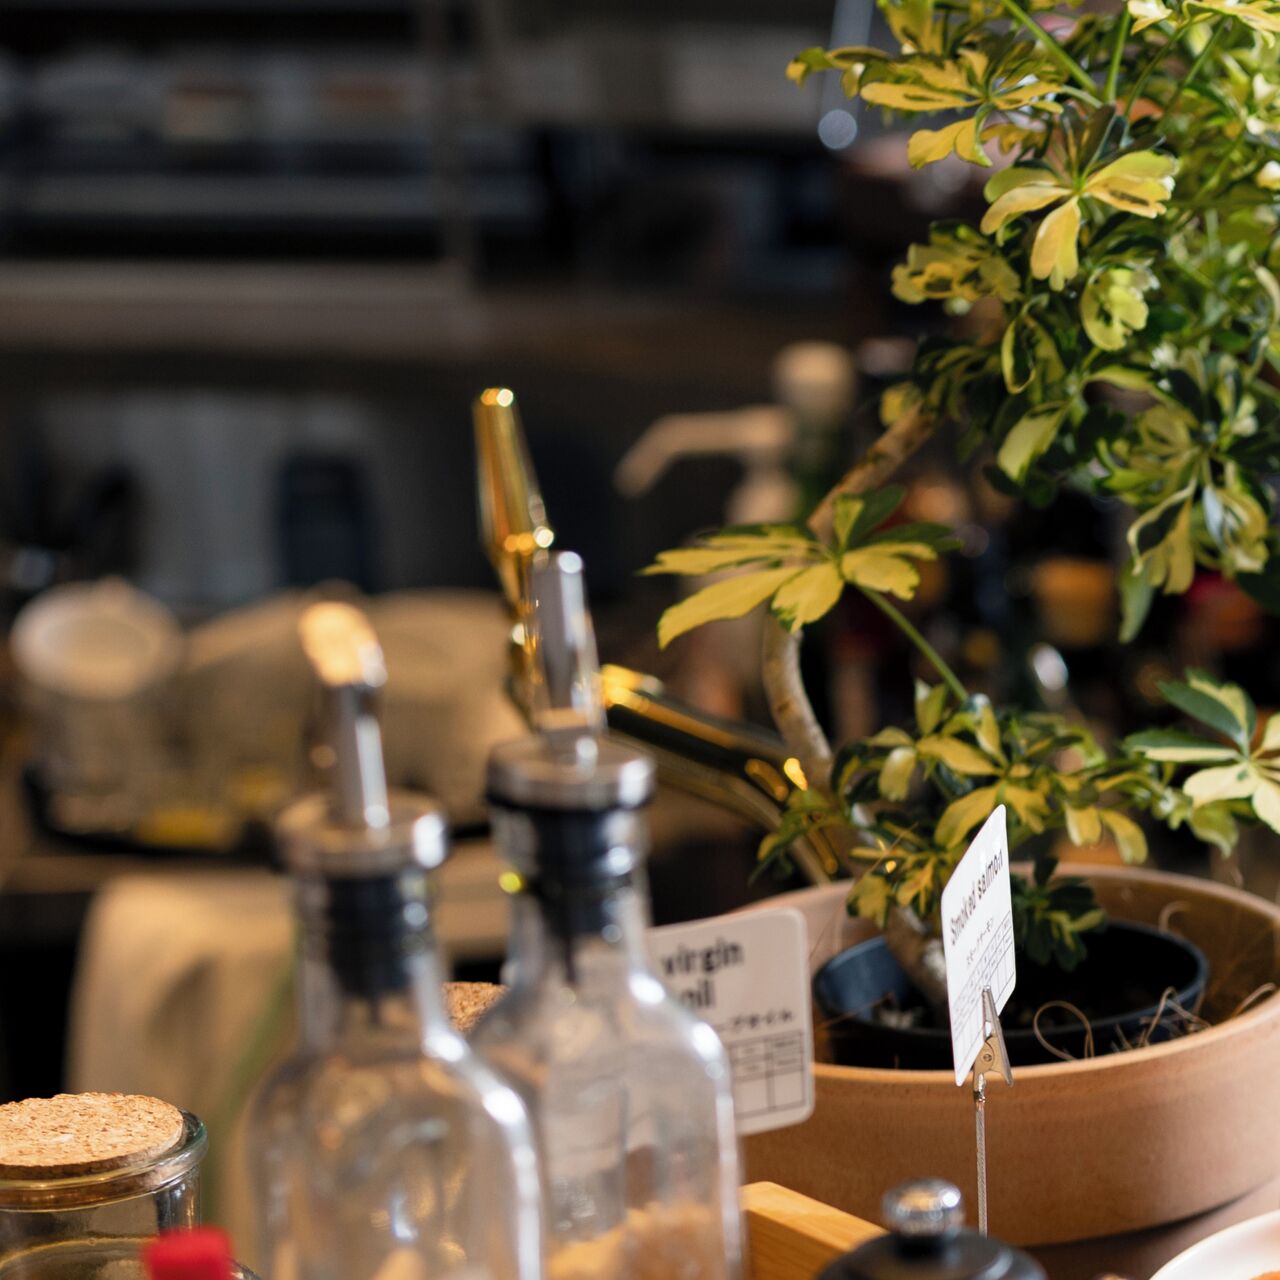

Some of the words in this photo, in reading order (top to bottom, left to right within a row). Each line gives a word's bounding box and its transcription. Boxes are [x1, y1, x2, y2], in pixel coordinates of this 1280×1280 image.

[951, 881, 977, 946] Smoked
[977, 848, 1003, 901] salmon
[661, 938, 744, 975] virgin
